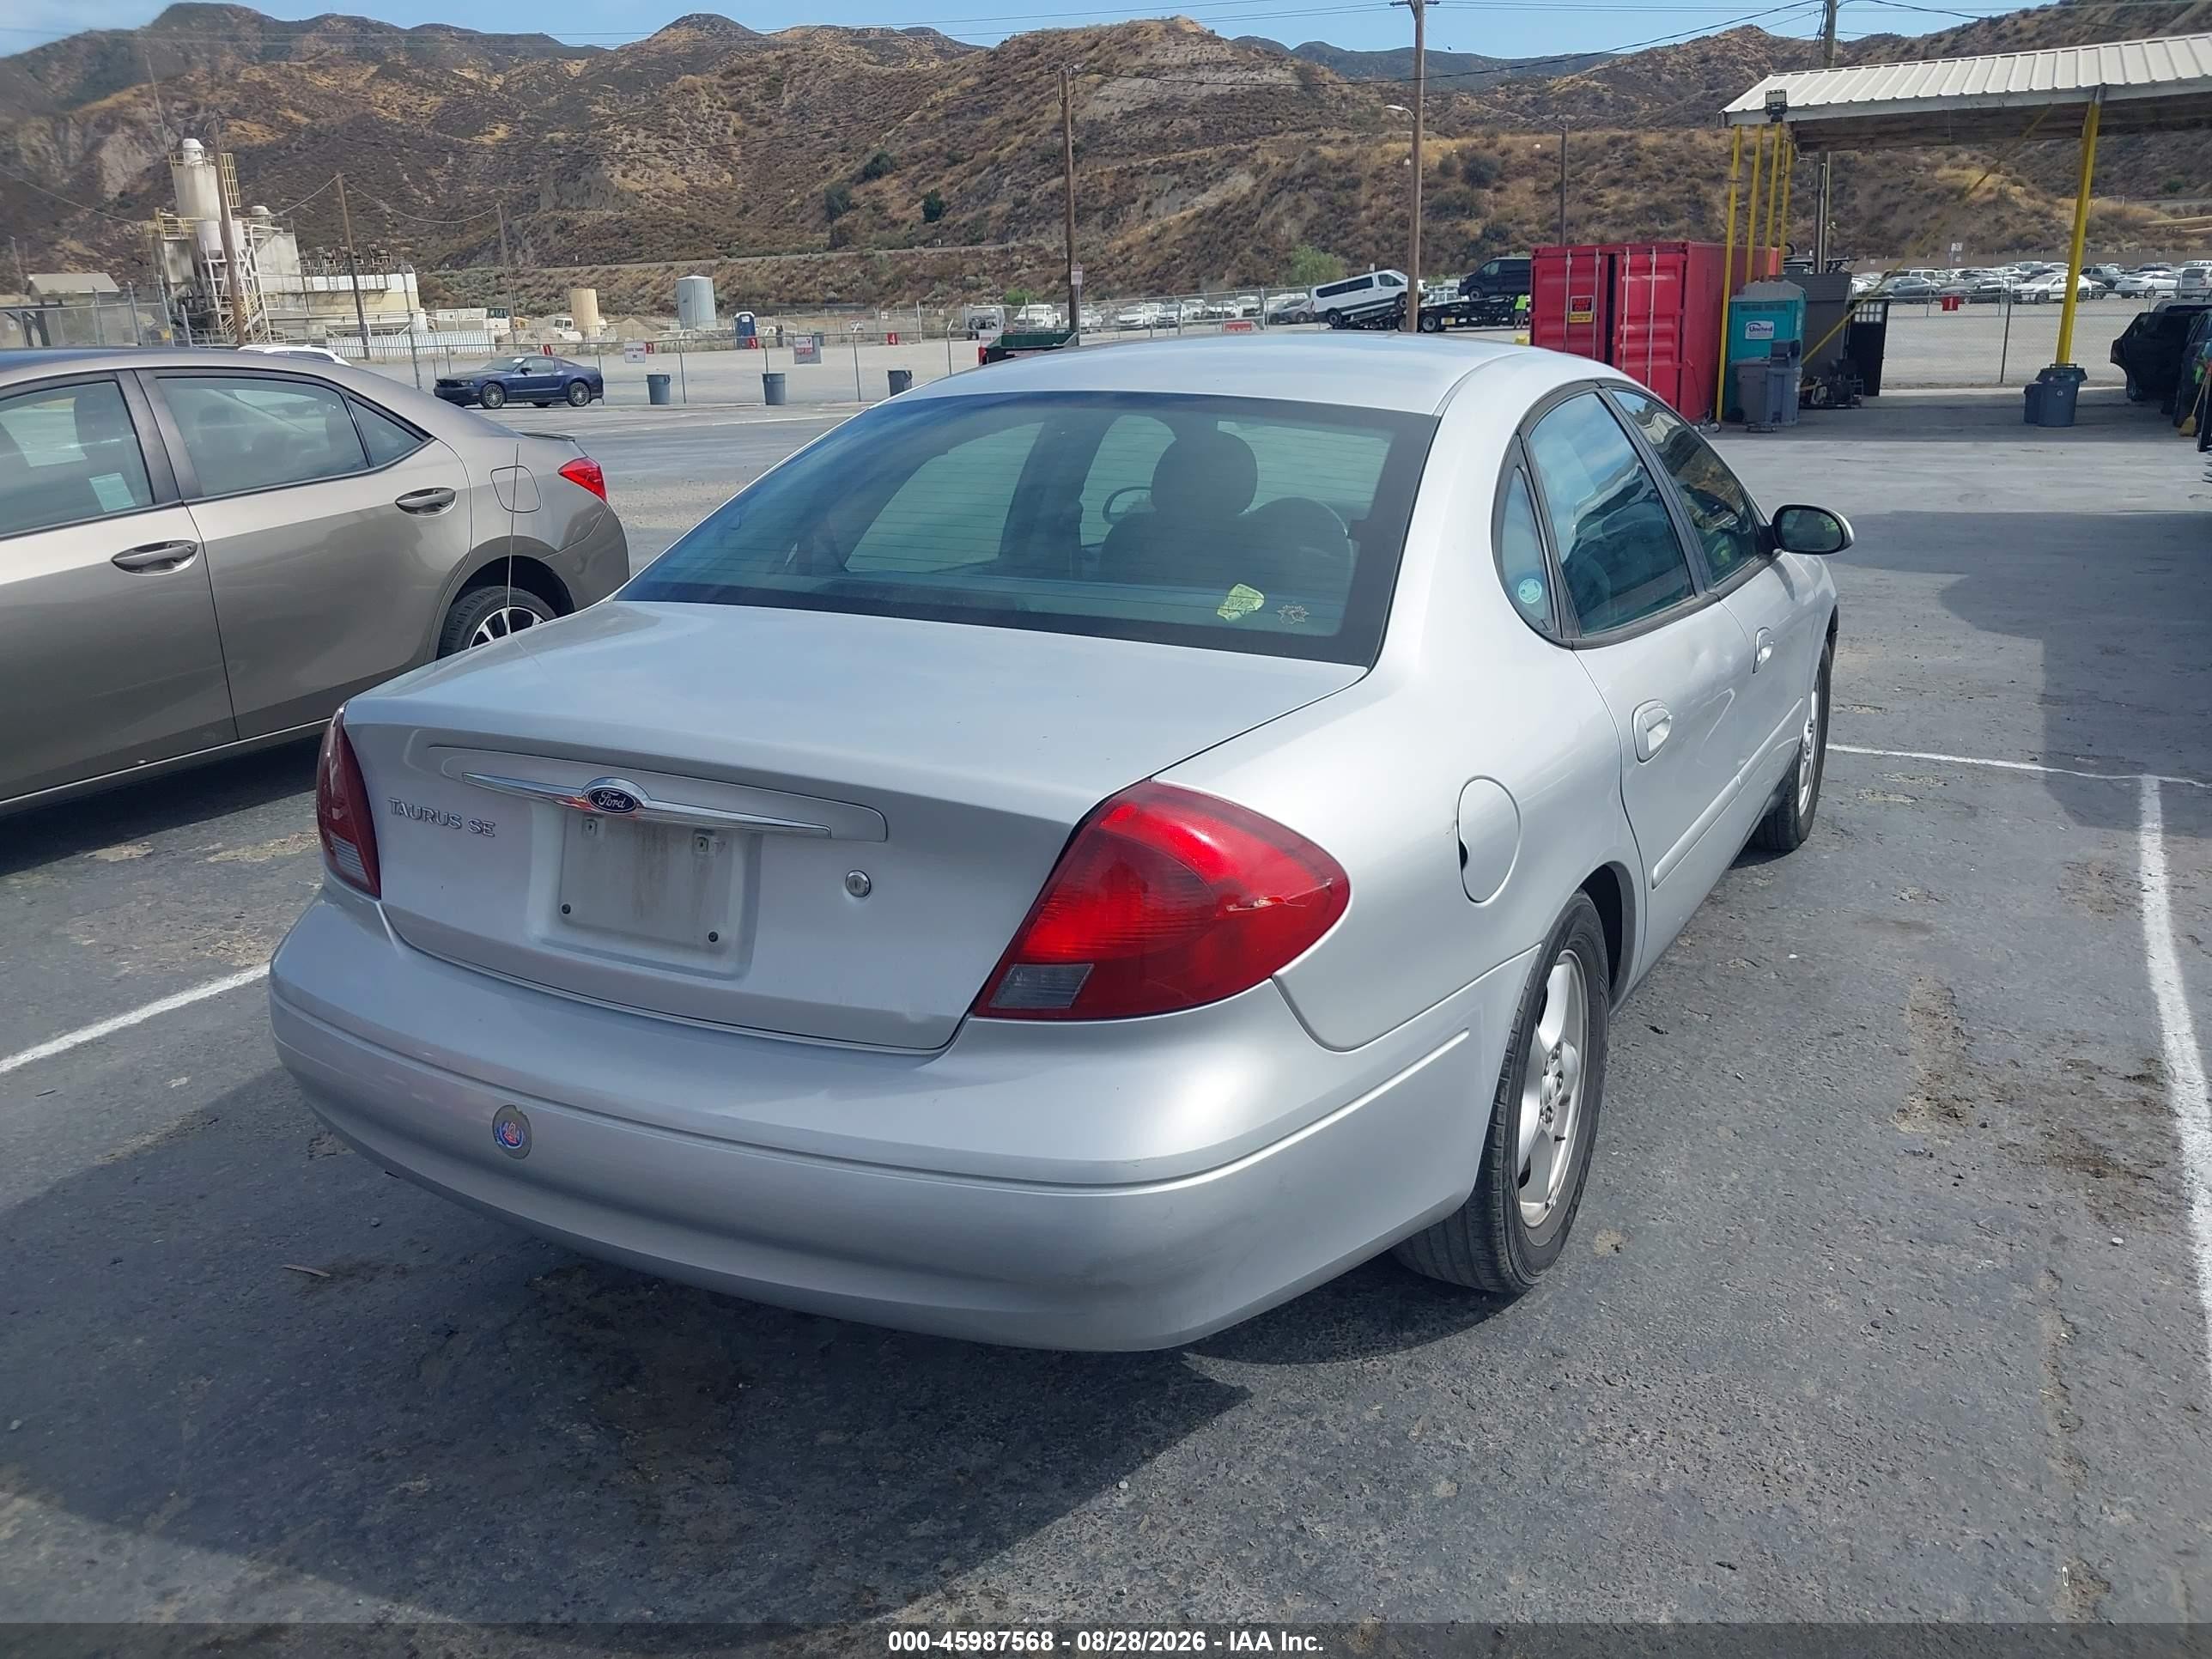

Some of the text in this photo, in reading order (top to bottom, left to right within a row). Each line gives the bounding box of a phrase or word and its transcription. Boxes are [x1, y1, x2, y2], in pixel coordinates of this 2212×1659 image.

[598, 790, 626, 809] Ford
[387, 798, 495, 837] TAURUS SE
